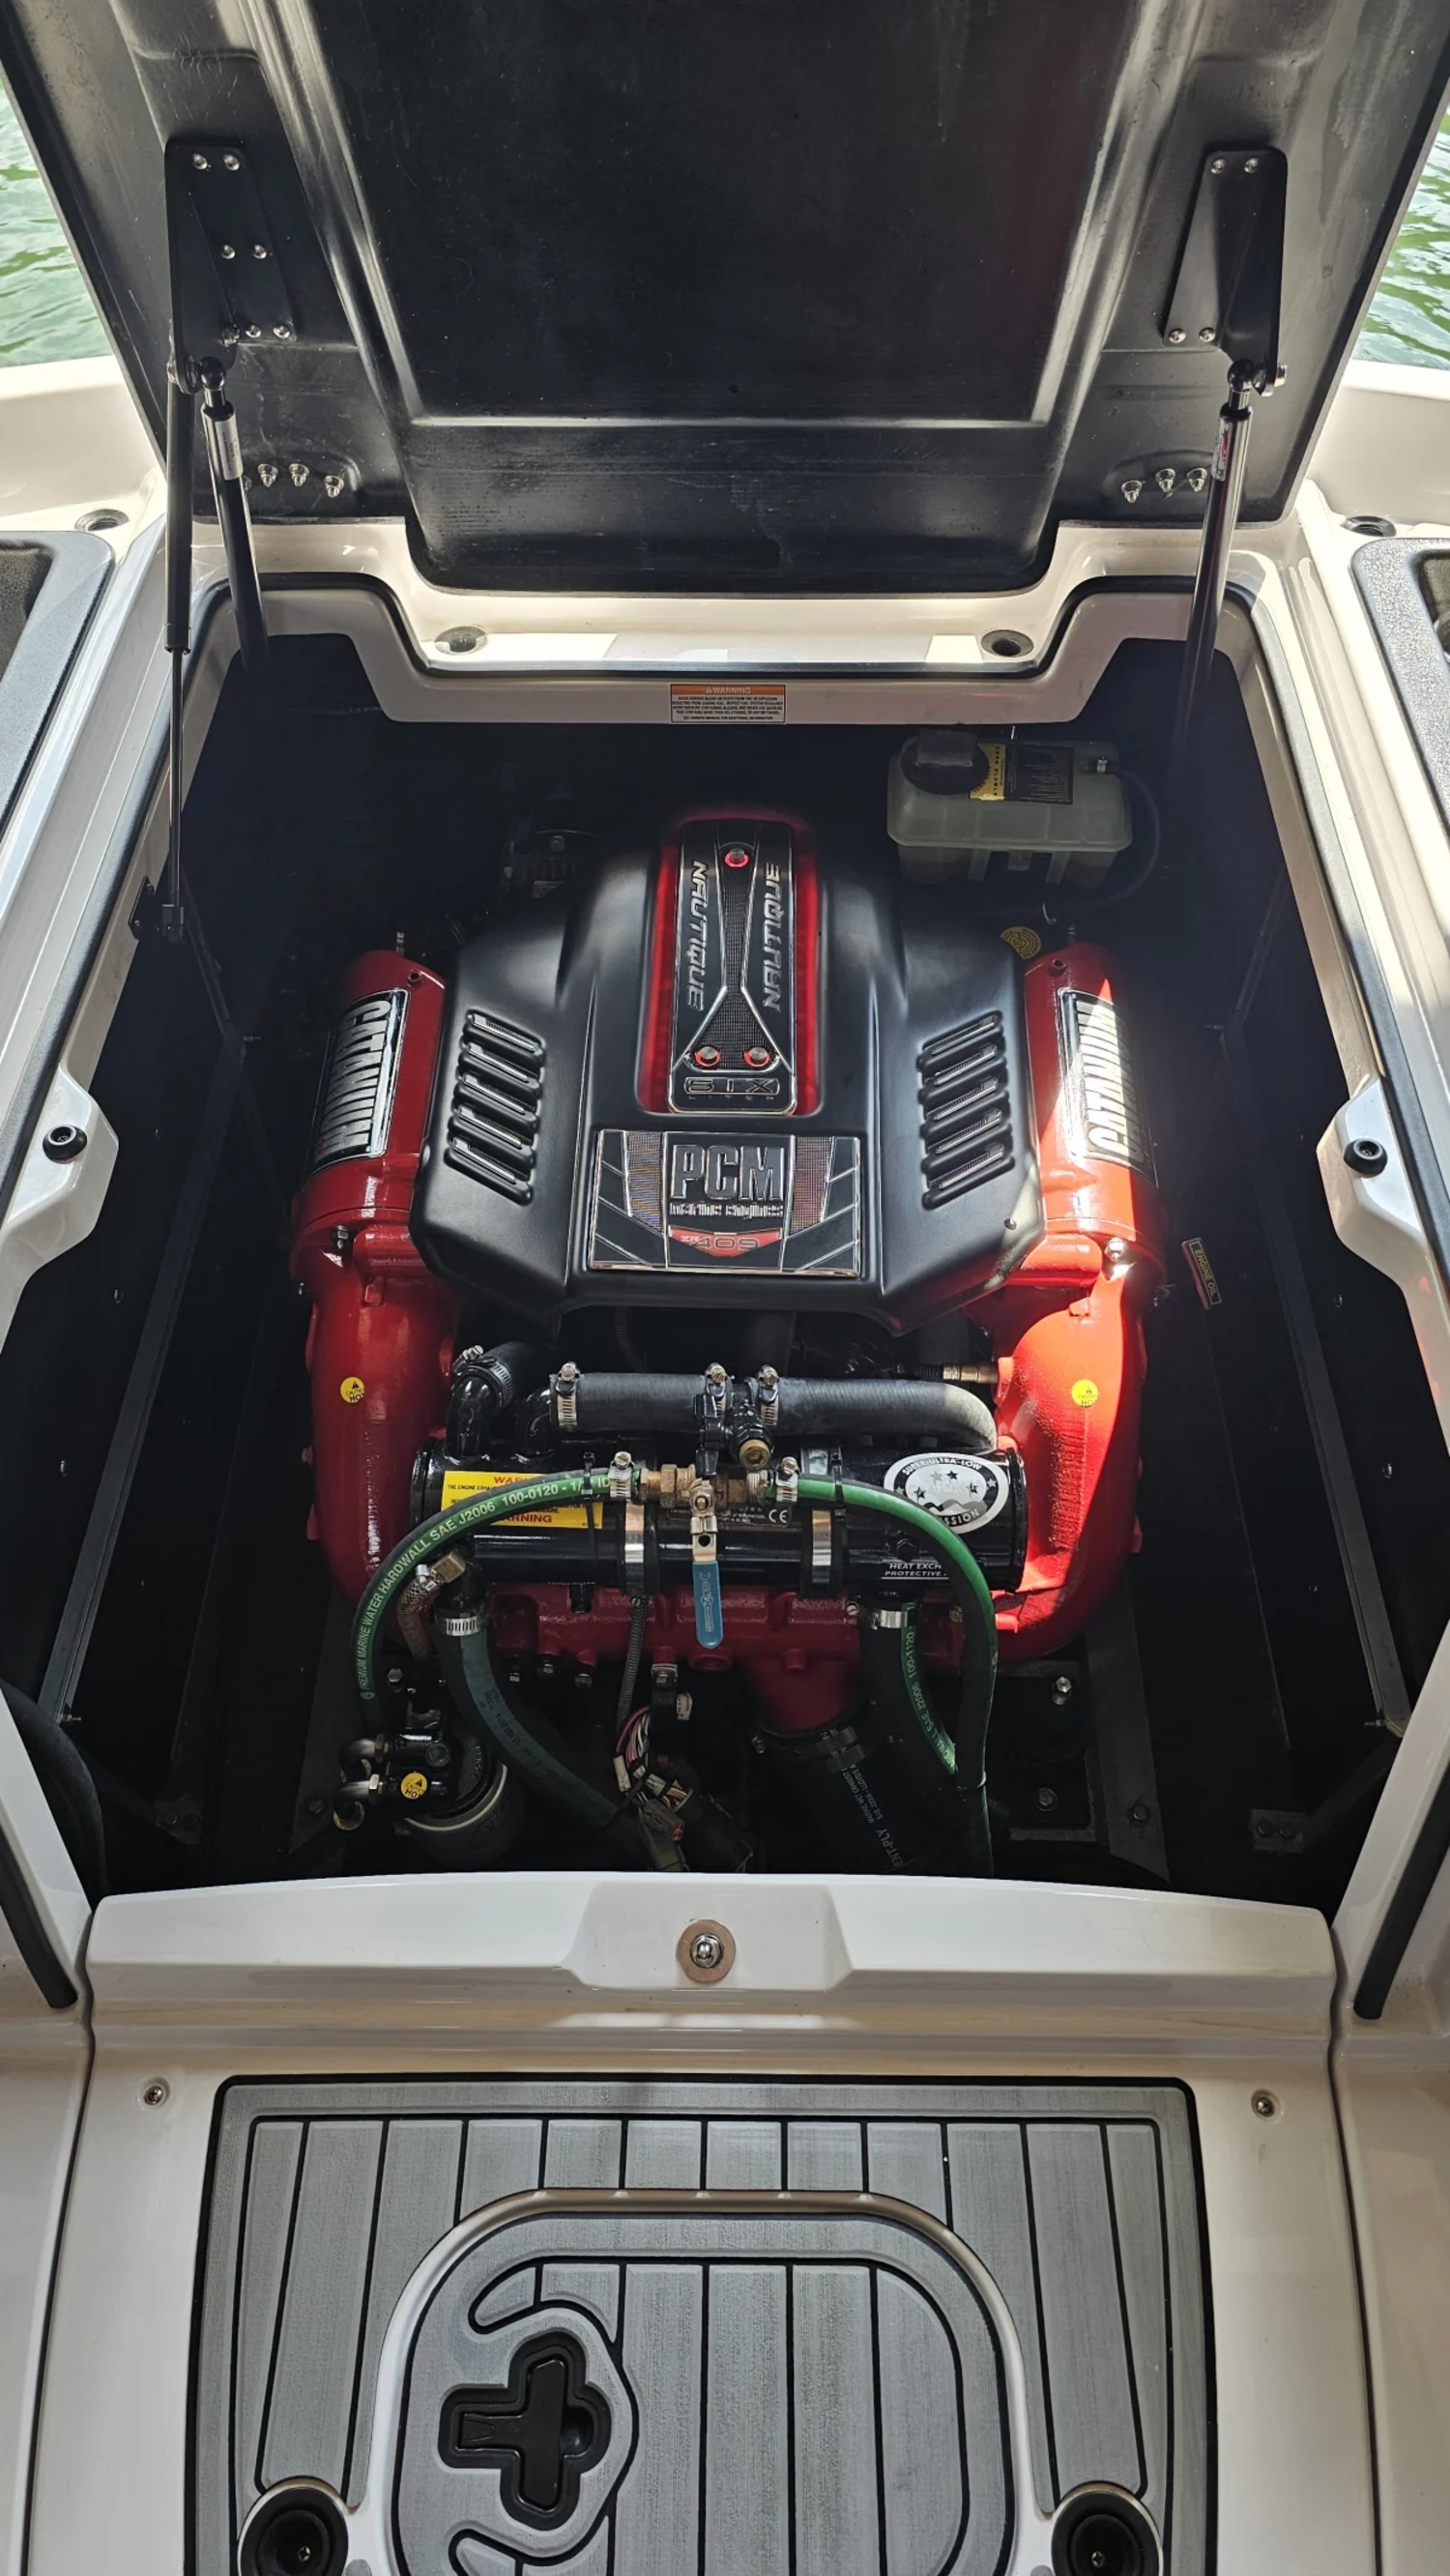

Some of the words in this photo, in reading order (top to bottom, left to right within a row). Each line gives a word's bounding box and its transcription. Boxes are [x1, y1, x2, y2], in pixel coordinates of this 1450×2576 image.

[686, 860, 709, 1012] NAUTIQUE
[762, 862, 784, 1012] NAUTIQUE
[316, 1000, 392, 1157] CATANIUM
[687, 1078, 775, 1093] SIX
[1077, 1001, 1146, 1161] CATANIUM
[669, 1144, 785, 1201] PCM
[691, 1236, 760, 1249] 409
[1194, 1249, 1212, 1281] ENGINE
[1206, 1279, 1217, 1298] OIL
[502, 1485, 559, 1508] 100-0120
[597, 1478, 611, 1488] ID
[458, 1502, 496, 1525] J2006
[505, 1513, 552, 1523] ARNING
[768, 1509, 788, 1523] CE
[942, 1508, 980, 1525] SSION
[429, 1522, 457, 1541] SAE
[378, 1538, 431, 1594] HARDWALL
[362, 1593, 383, 1625] WATER
[357, 1625, 371, 1657] MARINE
[905, 1630, 916, 1679] 100-1120
[912, 1682, 926, 1710] J2006
[921, 1711, 934, 1732] SAE
